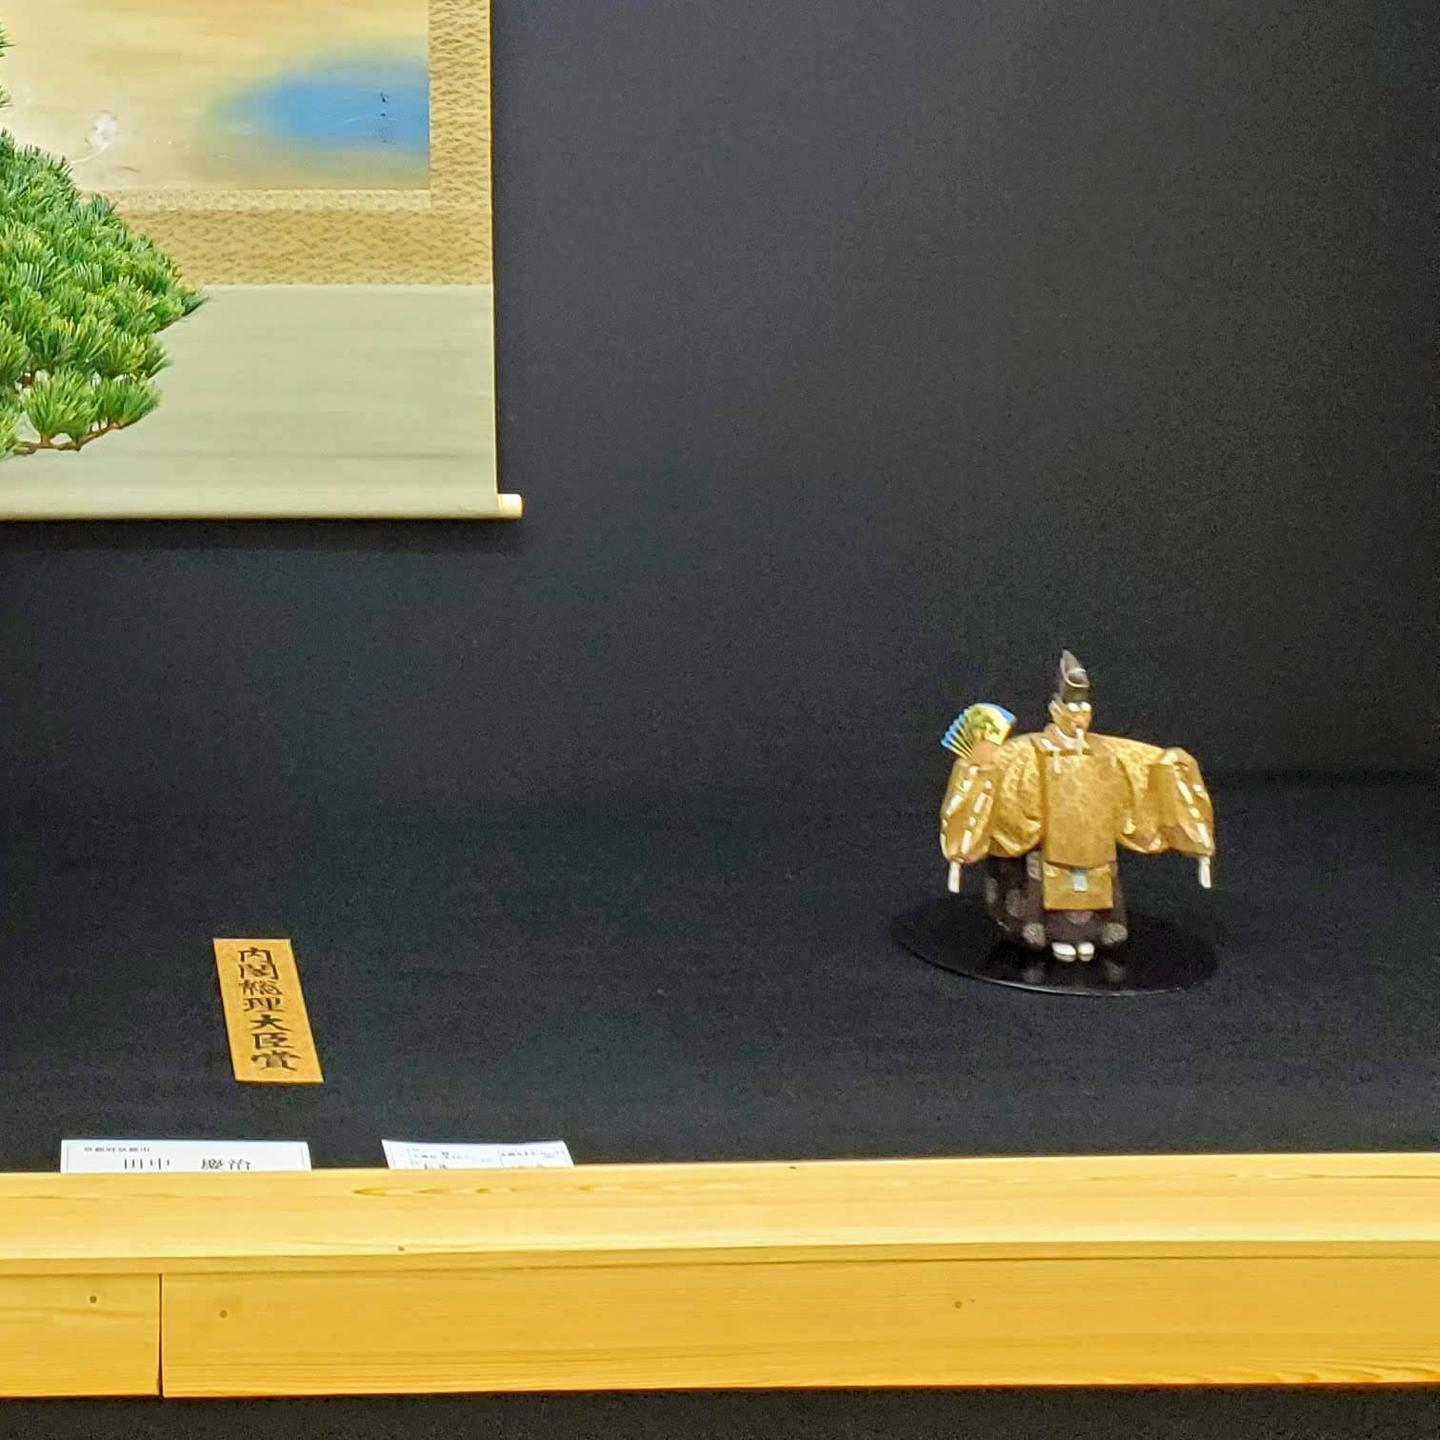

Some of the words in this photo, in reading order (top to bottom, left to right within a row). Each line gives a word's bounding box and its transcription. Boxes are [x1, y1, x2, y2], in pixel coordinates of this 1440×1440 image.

[237, 946, 301, 1072] 内閣総理大臣賞
